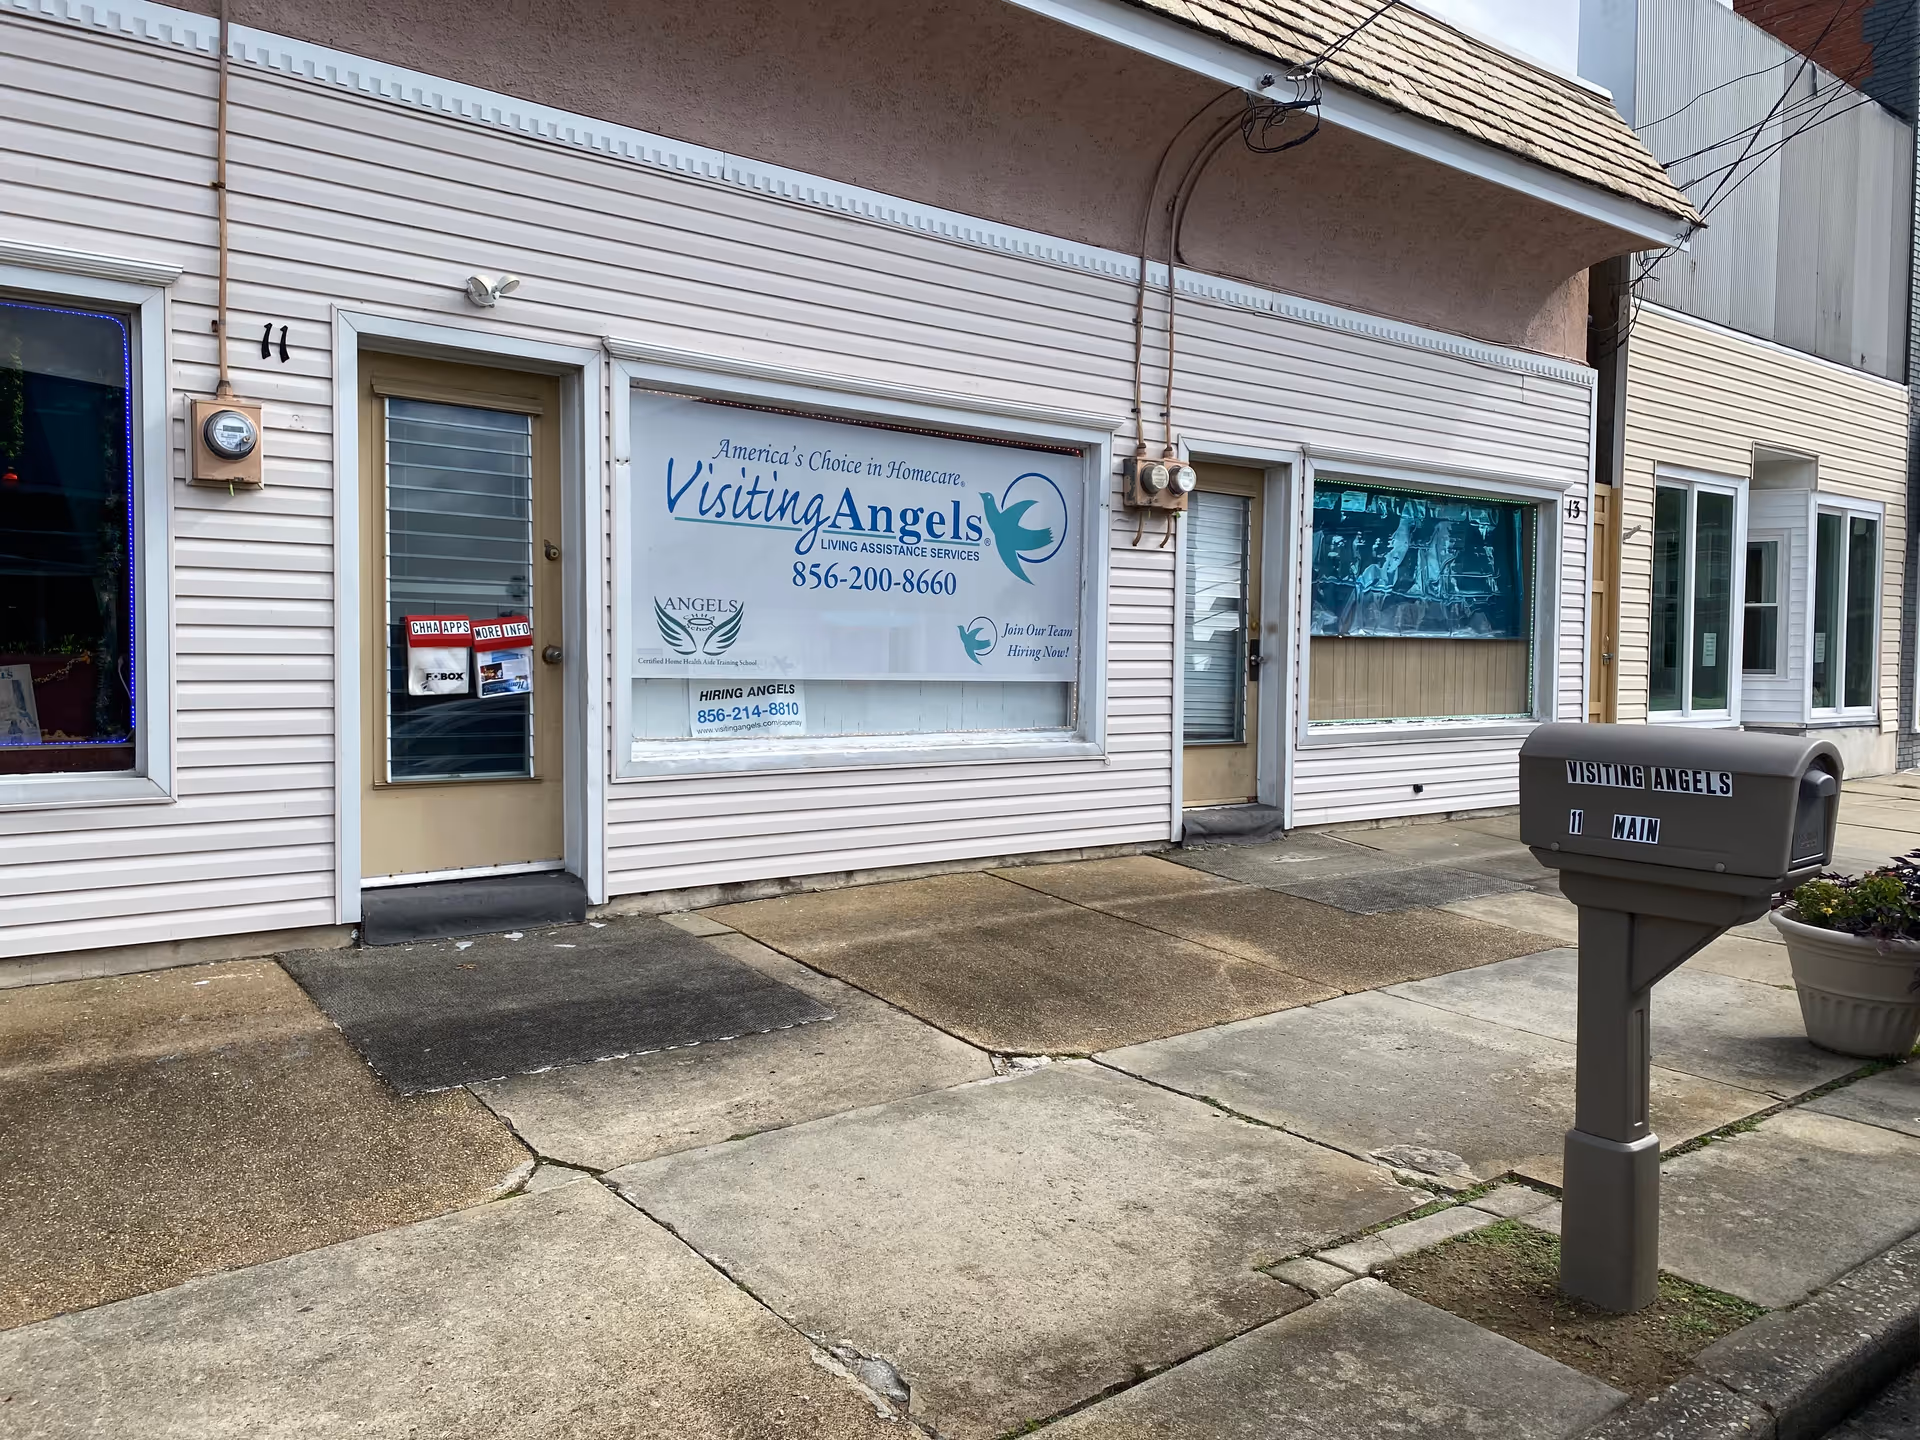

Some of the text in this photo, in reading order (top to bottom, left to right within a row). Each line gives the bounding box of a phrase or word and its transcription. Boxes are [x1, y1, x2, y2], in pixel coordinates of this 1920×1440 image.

[261, 322, 290, 363] 11
[712, 439, 804, 467] America's
[808, 450, 861, 474] Choice
[867, 457, 882, 477] in
[667, 457, 831, 555] Visiting
[1568, 500, 1580, 519] 13
[821, 538, 980, 562] LIVING ASSISTANCE SERVICES
[792, 560, 957, 596] 856-200-8660
[663, 597, 739, 613] ANGELS
[412, 621, 470, 634] CHHA APPS
[474, 624, 529, 639] MORE INFO
[1001, 623, 1073, 638] Join Our Team
[683, 658, 702, 666] Health
[716, 659, 738, 667] Training
[1007, 645, 1070, 661] Hiring Now!
[699, 683, 795, 701] HIRING ANGELS
[697, 702, 799, 724] 856-214-8810
[696, 719, 803, 734] www.visitingangels.com/capemay
[1567, 760, 1731, 795] VISITING ANGELS
[1570, 810, 1659, 843] 11 MAIN
